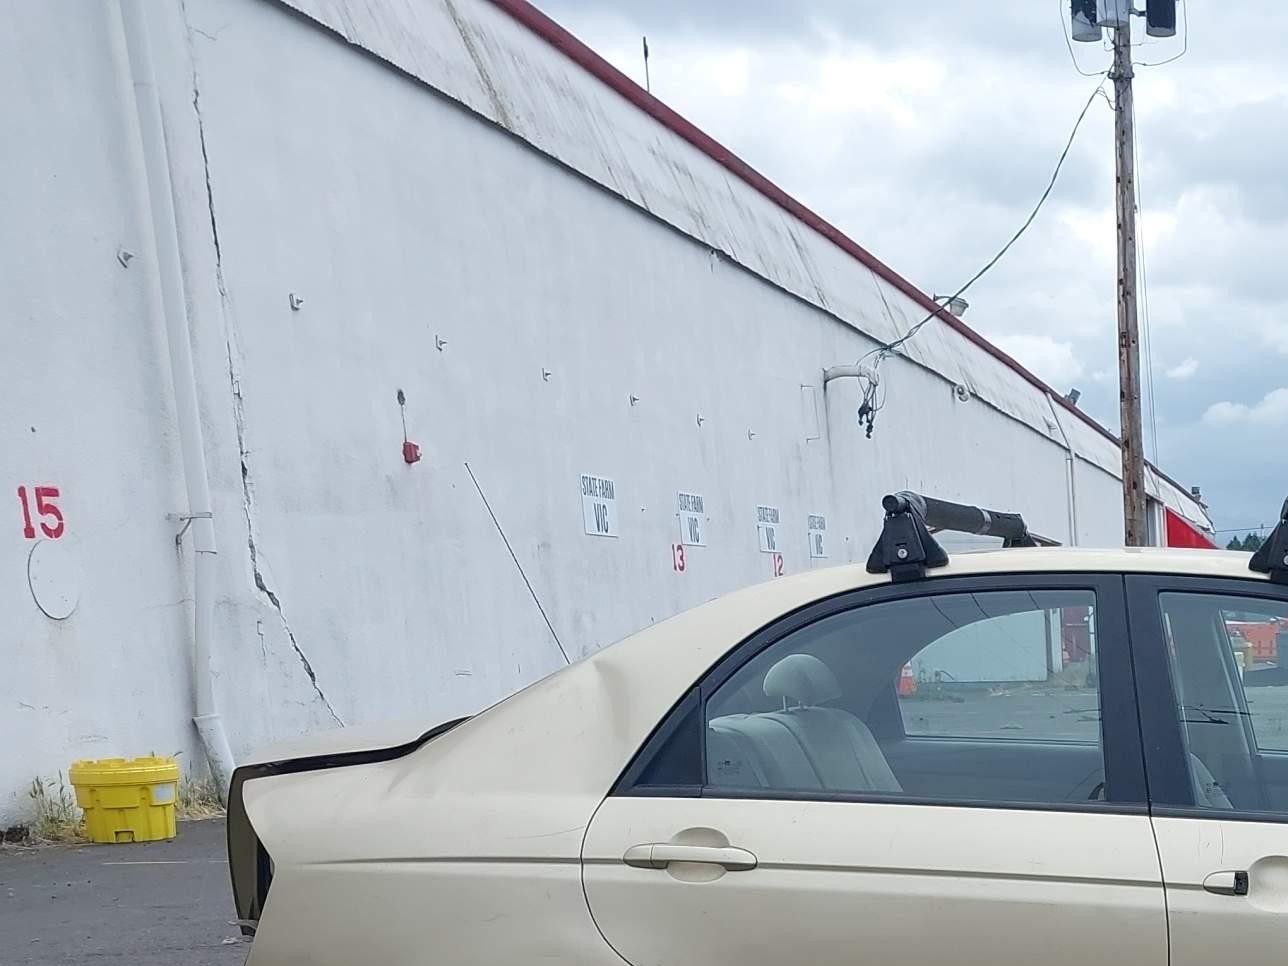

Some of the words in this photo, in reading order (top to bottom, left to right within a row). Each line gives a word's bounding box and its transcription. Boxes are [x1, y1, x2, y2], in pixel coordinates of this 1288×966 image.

[582, 476, 598, 496] STATE
[598, 479, 614, 499] FARM
[18, 486, 64, 538] 15
[679, 494, 690, 511] STATE
[690, 496, 703, 513] FARM
[594, 503, 608, 533] VIC
[688, 517, 699, 543] VIC
[672, 544, 685, 571] 13
[773, 553, 784, 577] 12
